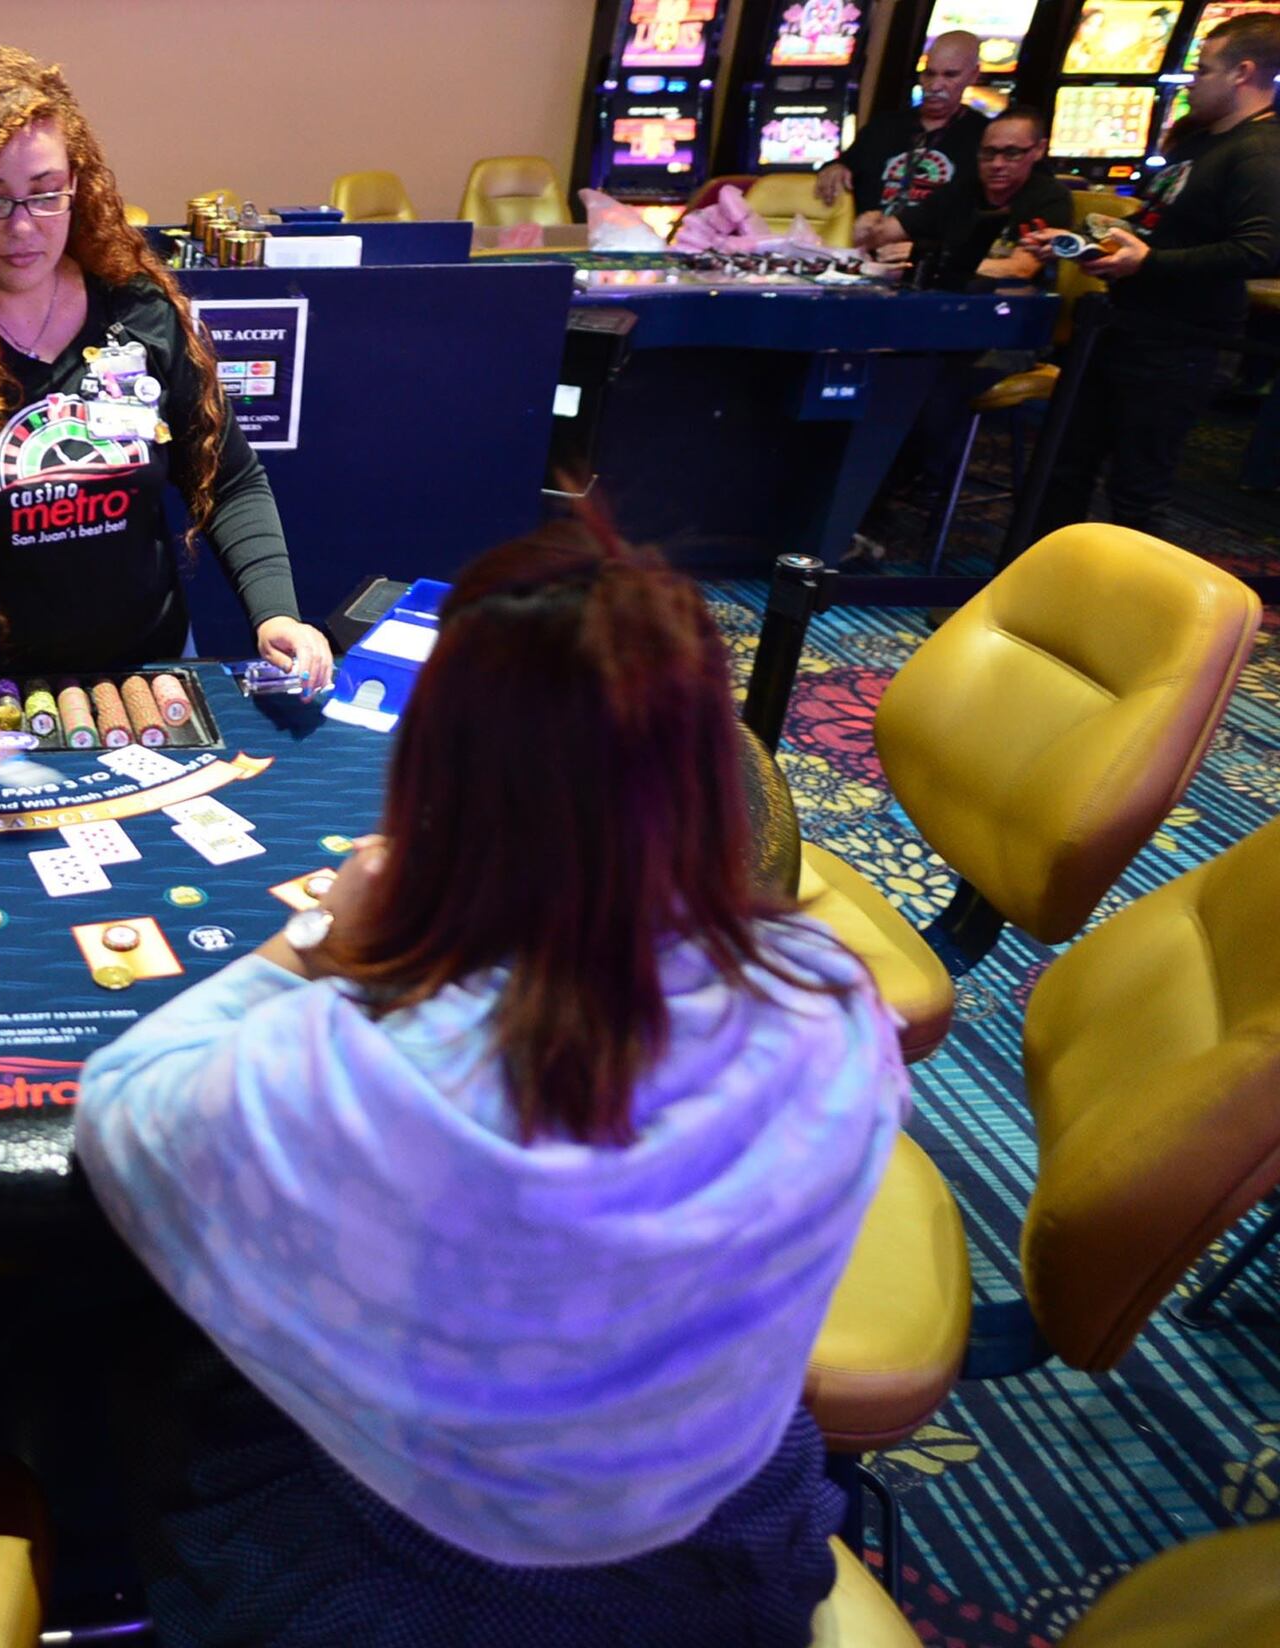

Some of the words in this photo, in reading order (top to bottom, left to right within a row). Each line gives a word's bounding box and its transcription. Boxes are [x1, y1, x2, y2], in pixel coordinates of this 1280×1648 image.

[211, 330, 233, 340] WE
[234, 329, 287, 340] ACCEPT
[9, 483, 79, 508] casino
[11, 489, 130, 532] metro
[11, 532, 37, 546] San
[38, 527, 76, 544] Juan's
[79, 522, 104, 538] best
[1, 783, 61, 797] PAYS
[63, 780, 78, 789] 3
[78, 771, 110, 784] TO
[22, 798, 56, 810] Will
[58, 791, 104, 805] Push
[103, 783, 139, 797] with
